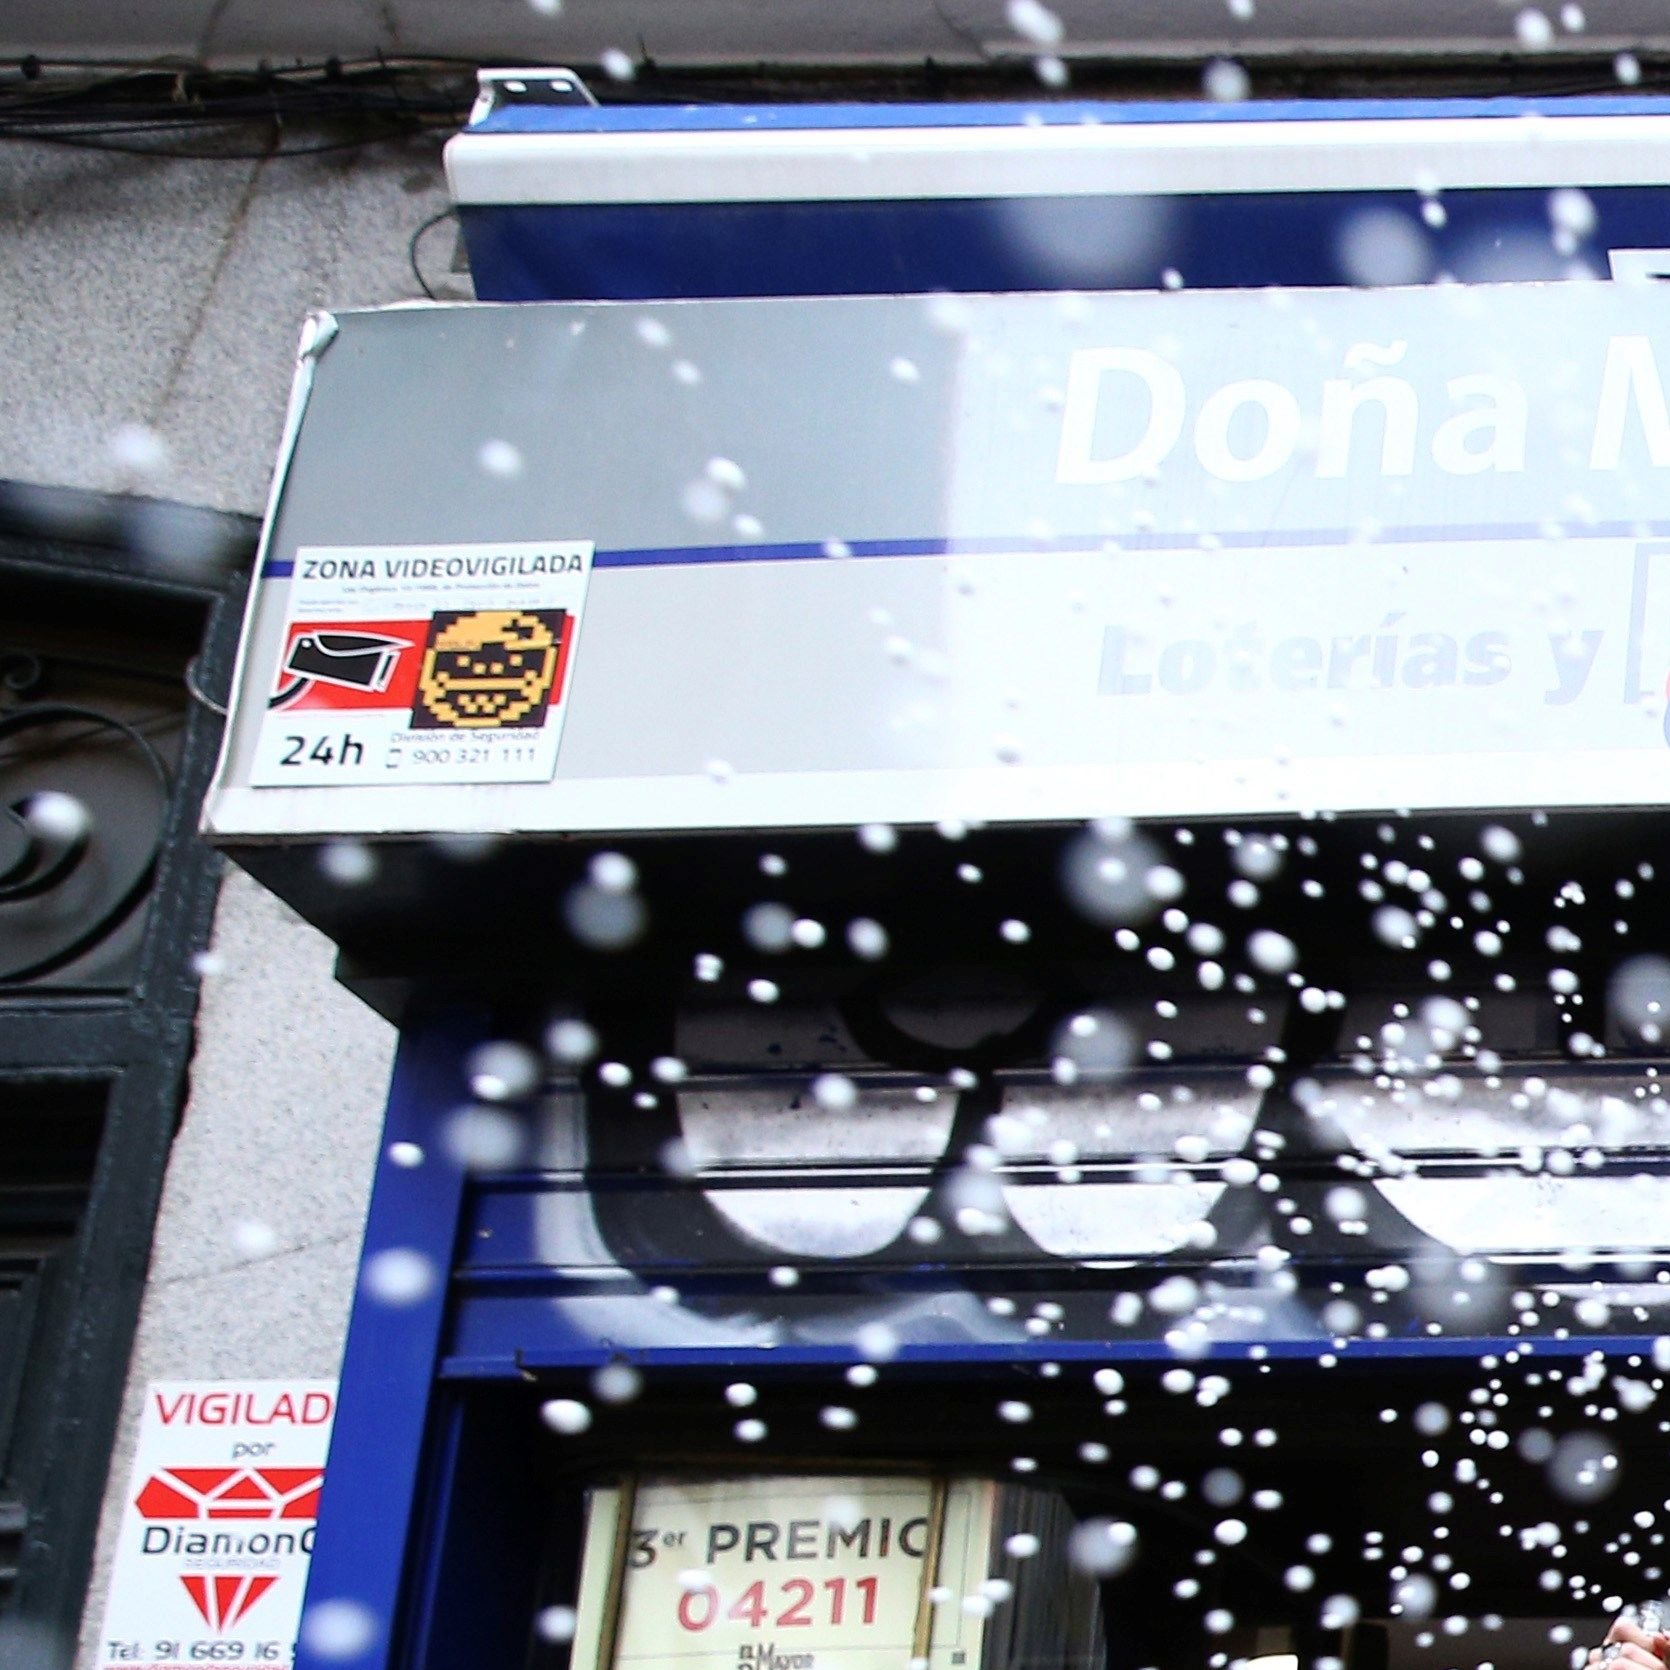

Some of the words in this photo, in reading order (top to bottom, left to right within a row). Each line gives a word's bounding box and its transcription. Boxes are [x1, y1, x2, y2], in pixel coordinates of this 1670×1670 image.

[1055, 339, 1529, 484] Doña
[302, 558, 376, 579] ZONA
[384, 553, 584, 579] VIDEOVIGILADA
[1097, 611, 1512, 695] Loterías
[1543, 630, 1605, 706] y
[279, 733, 364, 766] 24h
[413, 749, 450, 765] 900
[457, 748, 490, 764] 321
[232, 1441, 276, 1460] por
[677, 1574, 879, 1633] 04211
[155, 1639, 180, 1661] 91
[190, 1639, 245, 1661] 669
[254, 1641, 279, 1661] 16
